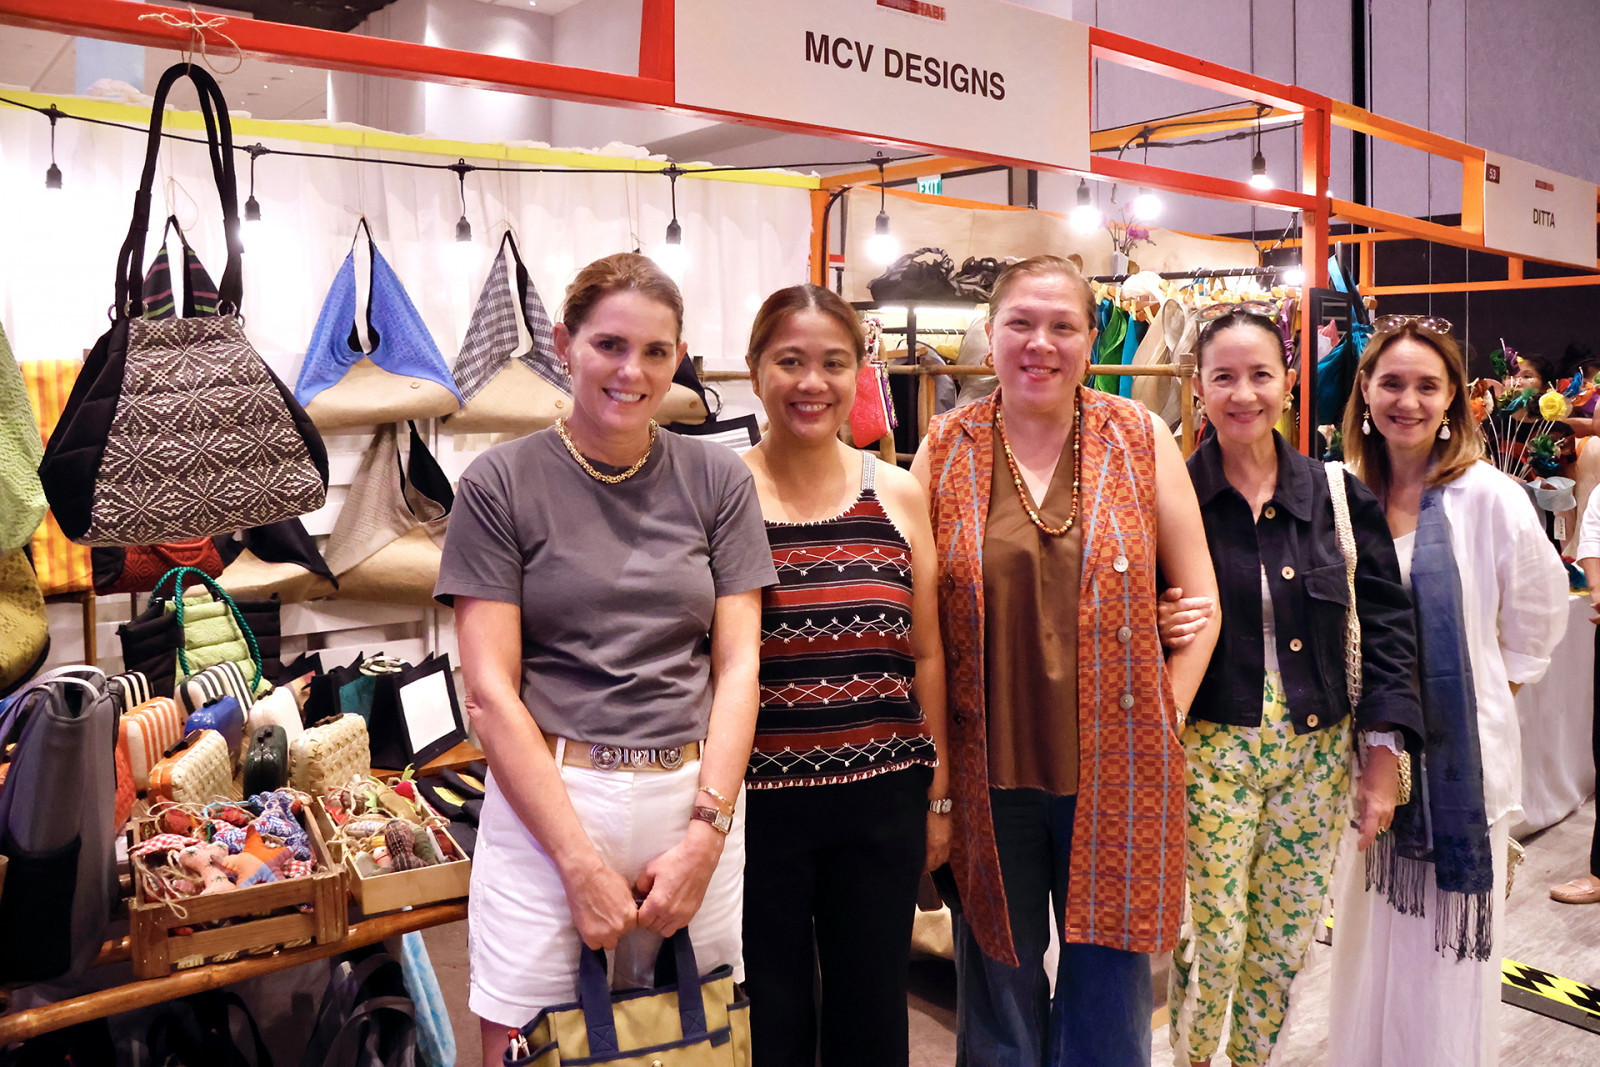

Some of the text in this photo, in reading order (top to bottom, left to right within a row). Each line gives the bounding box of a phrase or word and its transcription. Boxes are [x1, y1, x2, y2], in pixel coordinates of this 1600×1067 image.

[805, 30, 1006, 101] MCV DESIGNS
[1489, 168, 1497, 180] 53
[919, 179, 939, 195] EXIT
[1533, 208, 1556, 229] DITTA
